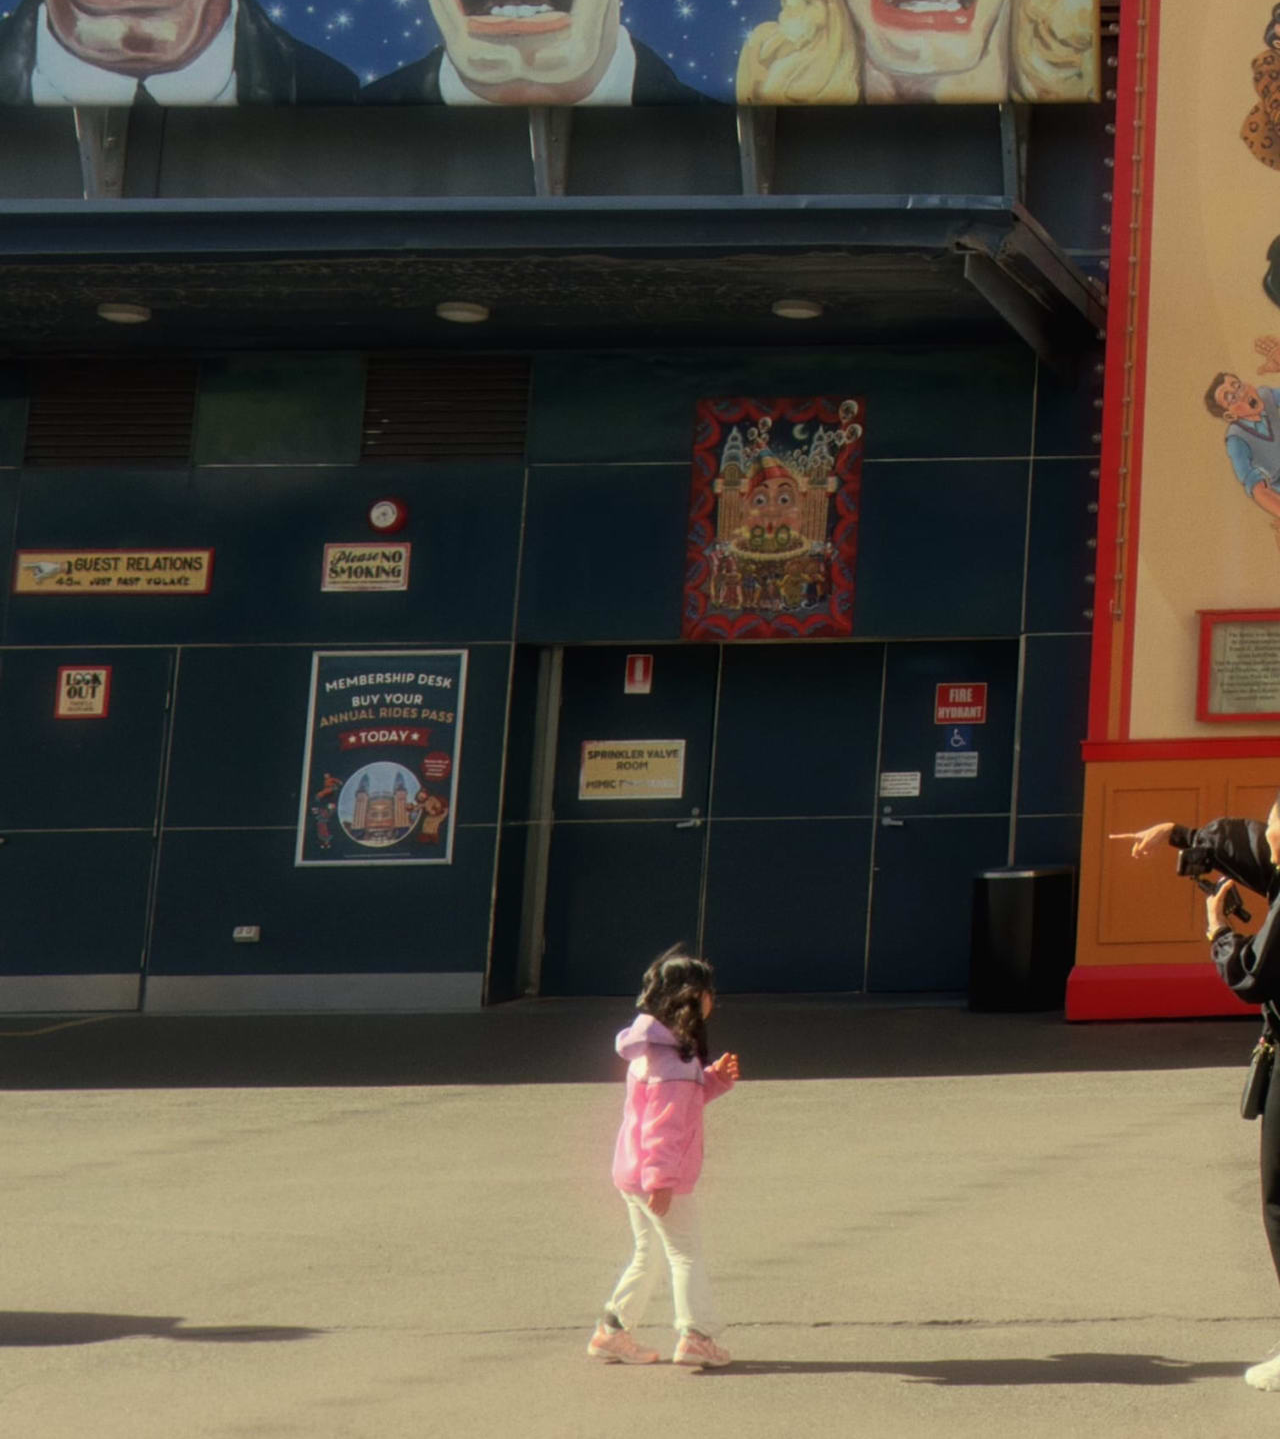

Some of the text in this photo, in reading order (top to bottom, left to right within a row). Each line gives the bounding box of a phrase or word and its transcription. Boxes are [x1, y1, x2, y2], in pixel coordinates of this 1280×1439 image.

[74, 556, 202, 571] GUEST RELATIONS
[330, 550, 402, 566] Please NO
[328, 565, 401, 579] SMOKING
[325, 672, 453, 692] MEMBERSHIP DESK
[67, 686, 99, 699] OUT
[949, 688, 973, 703] FIRE
[352, 694, 423, 707] BUY YOUR
[319, 707, 454, 728] ANNUAL RIDES PASS
[938, 706, 983, 719] HYDRANT
[359, 730, 409, 743] TODAY
[588, 749, 679, 760] SPRINKLER VALVE
[616, 761, 648, 770] ROOM
